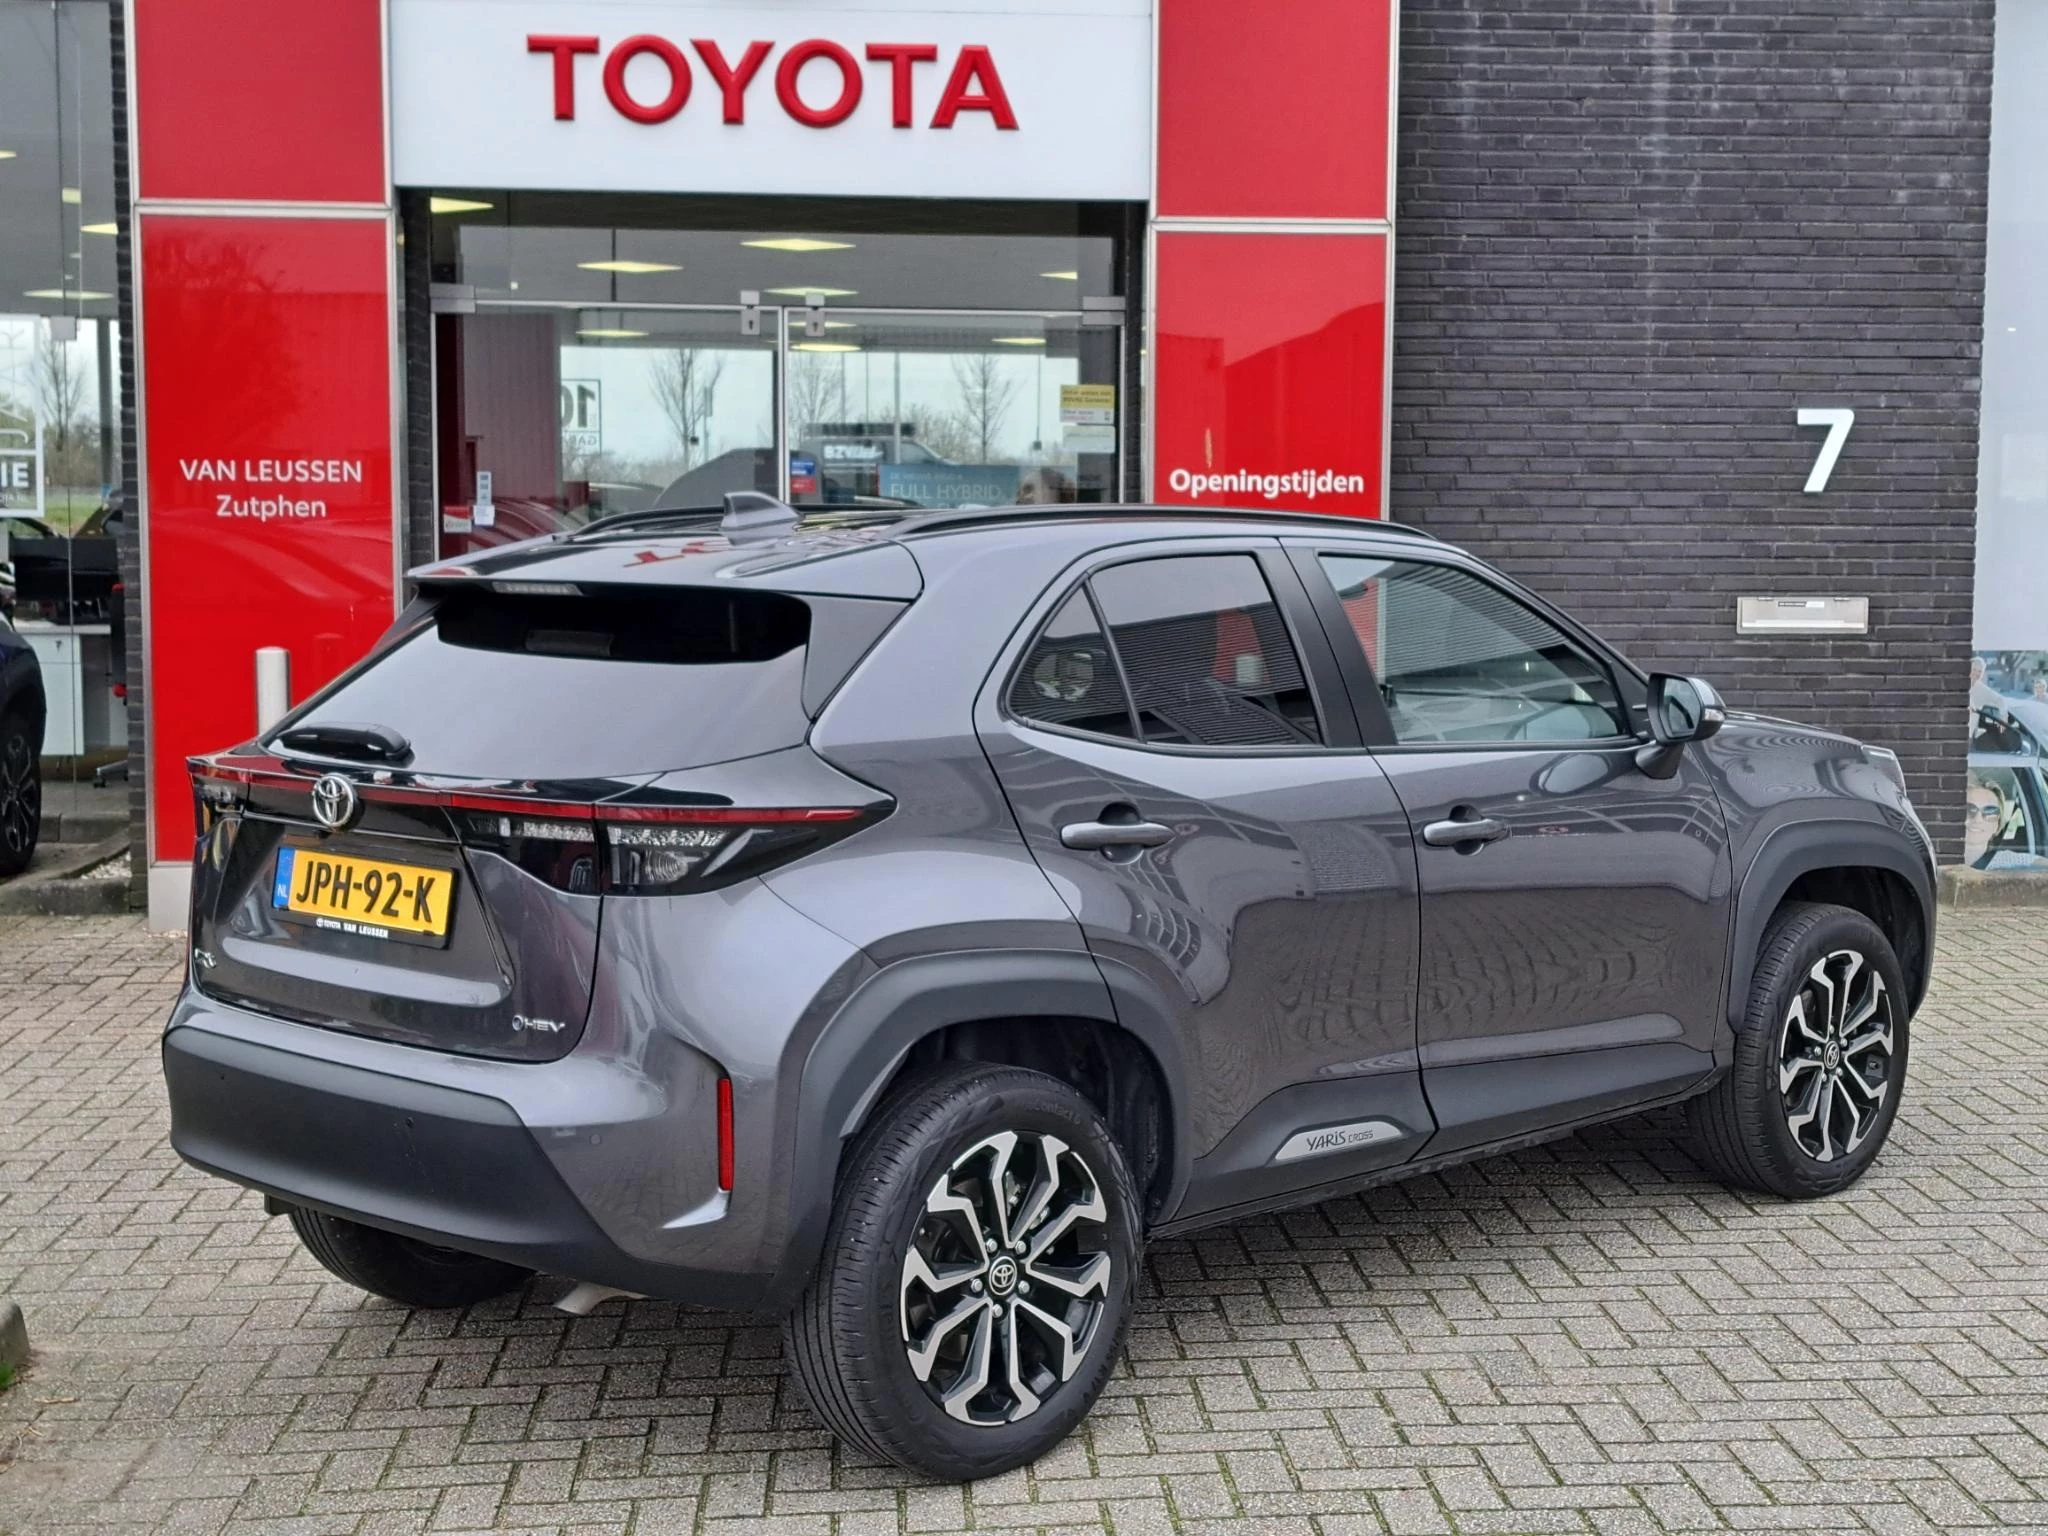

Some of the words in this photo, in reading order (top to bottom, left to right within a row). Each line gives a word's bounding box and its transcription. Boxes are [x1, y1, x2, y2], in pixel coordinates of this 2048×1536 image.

[527, 33, 1020, 130] TOYOTA
[1797, 408, 1855, 492] 7
[179, 459, 236, 481] VAN
[245, 459, 362, 482] LEUSSEN
[890, 483, 933, 499] FULL
[936, 483, 1001, 501] HYBRID
[1169, 468, 1364, 499] Openingstijden
[216, 494, 326, 522] Zutphen
[276, 884, 288, 898] NL
[296, 860, 436, 923] JPH-92-K
[343, 922, 357, 934] VAN
[358, 925, 389, 939] LEUSSEN
[524, 1017, 566, 1033] HEV
[1348, 1130, 1374, 1144] CROSS
